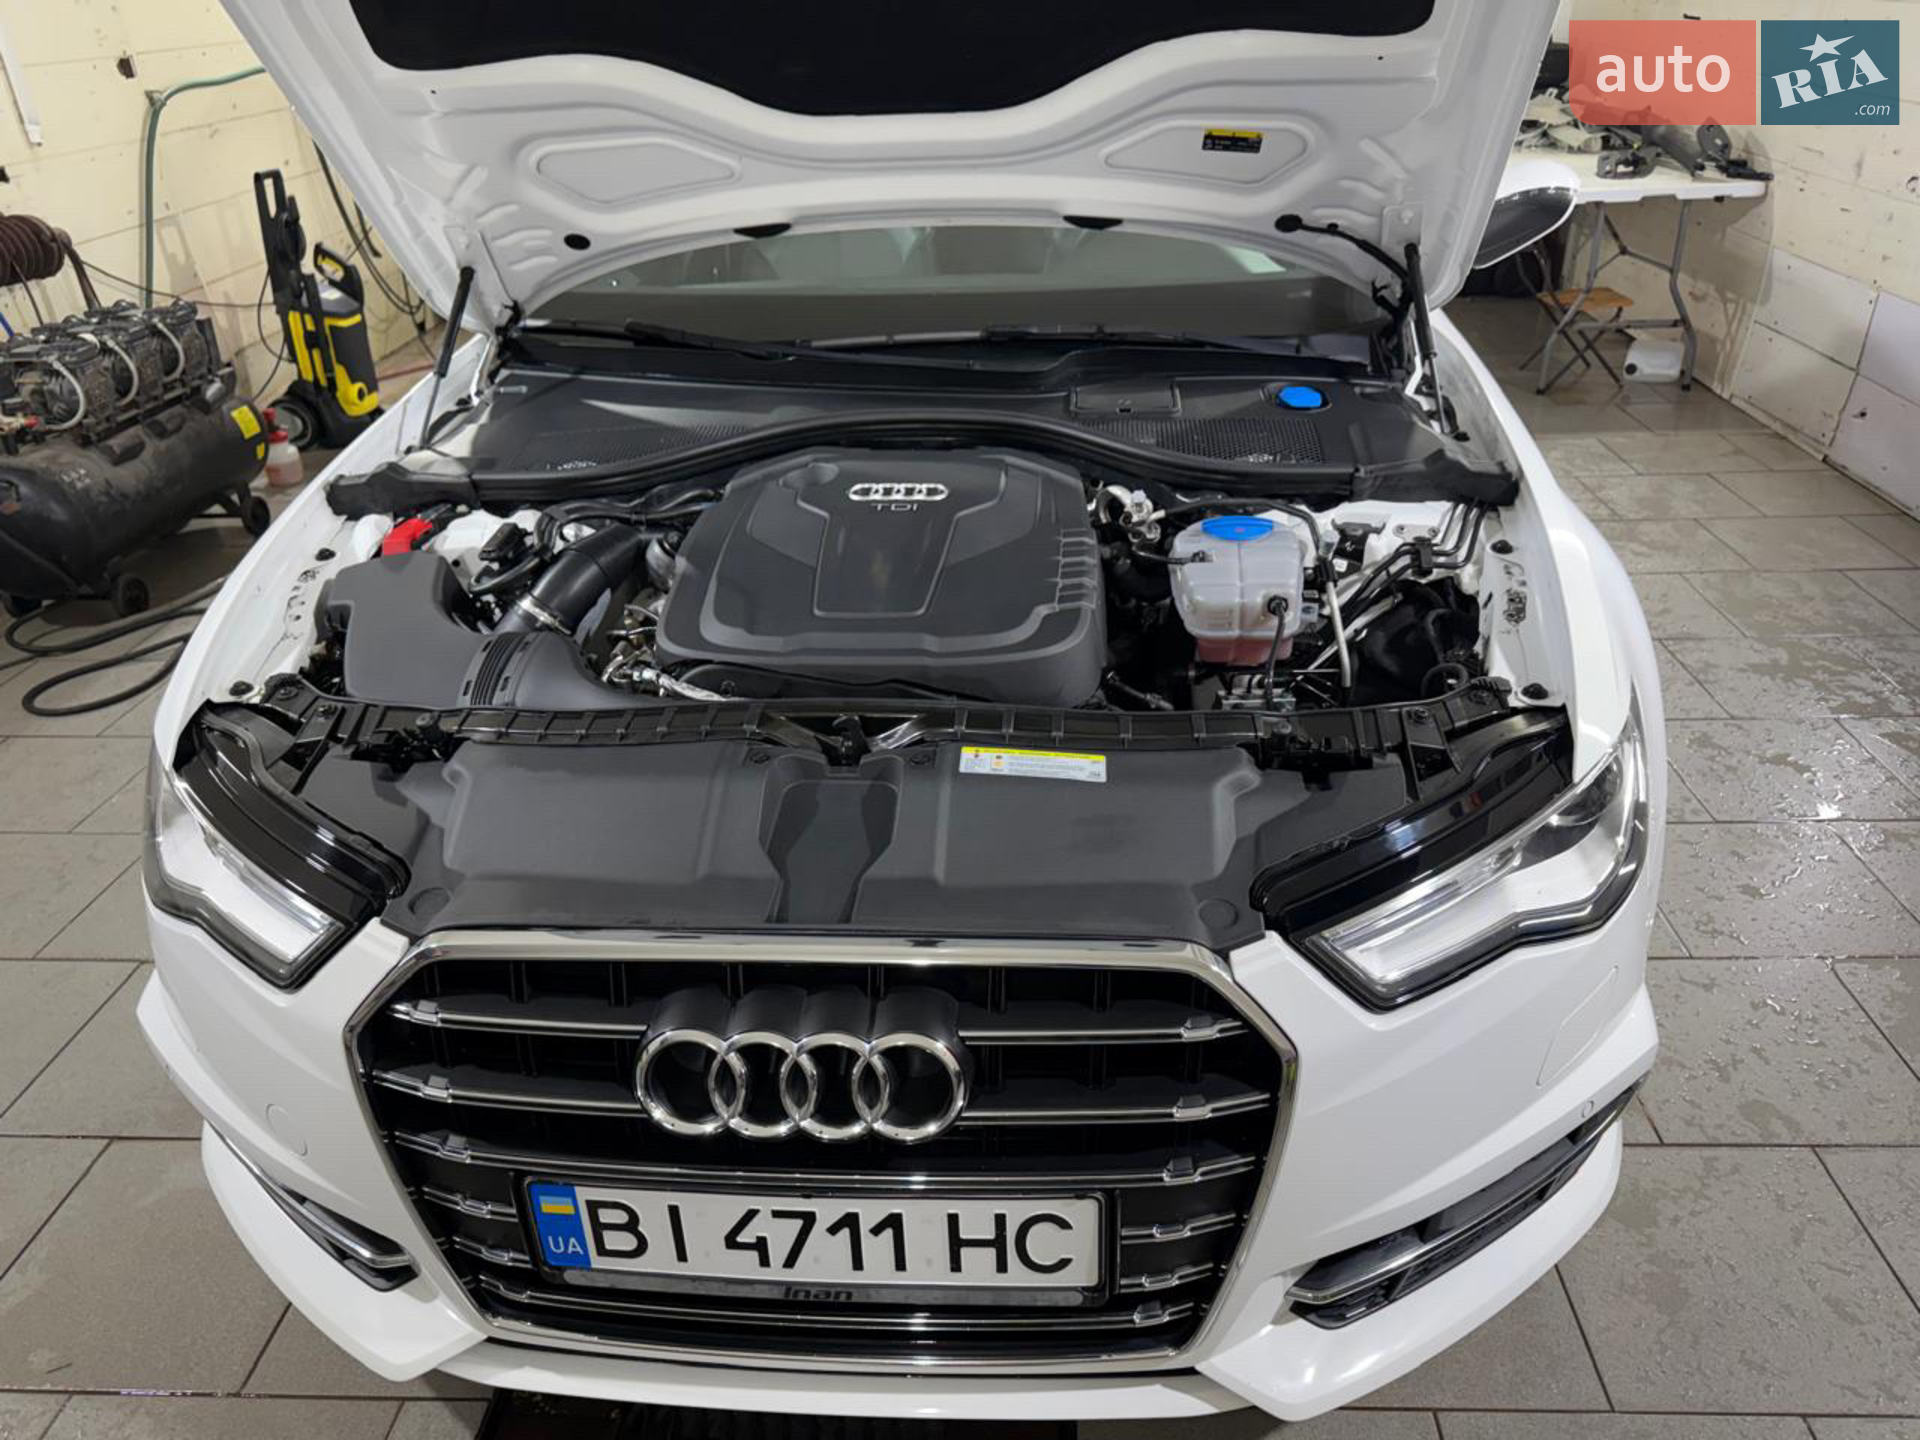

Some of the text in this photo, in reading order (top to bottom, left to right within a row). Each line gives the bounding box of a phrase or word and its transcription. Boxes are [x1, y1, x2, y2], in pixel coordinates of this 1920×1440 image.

[871, 503, 919, 511] TDI
[548, 1236, 584, 1254] UA
[585, 1199, 1074, 1274] BI 4711 HC
